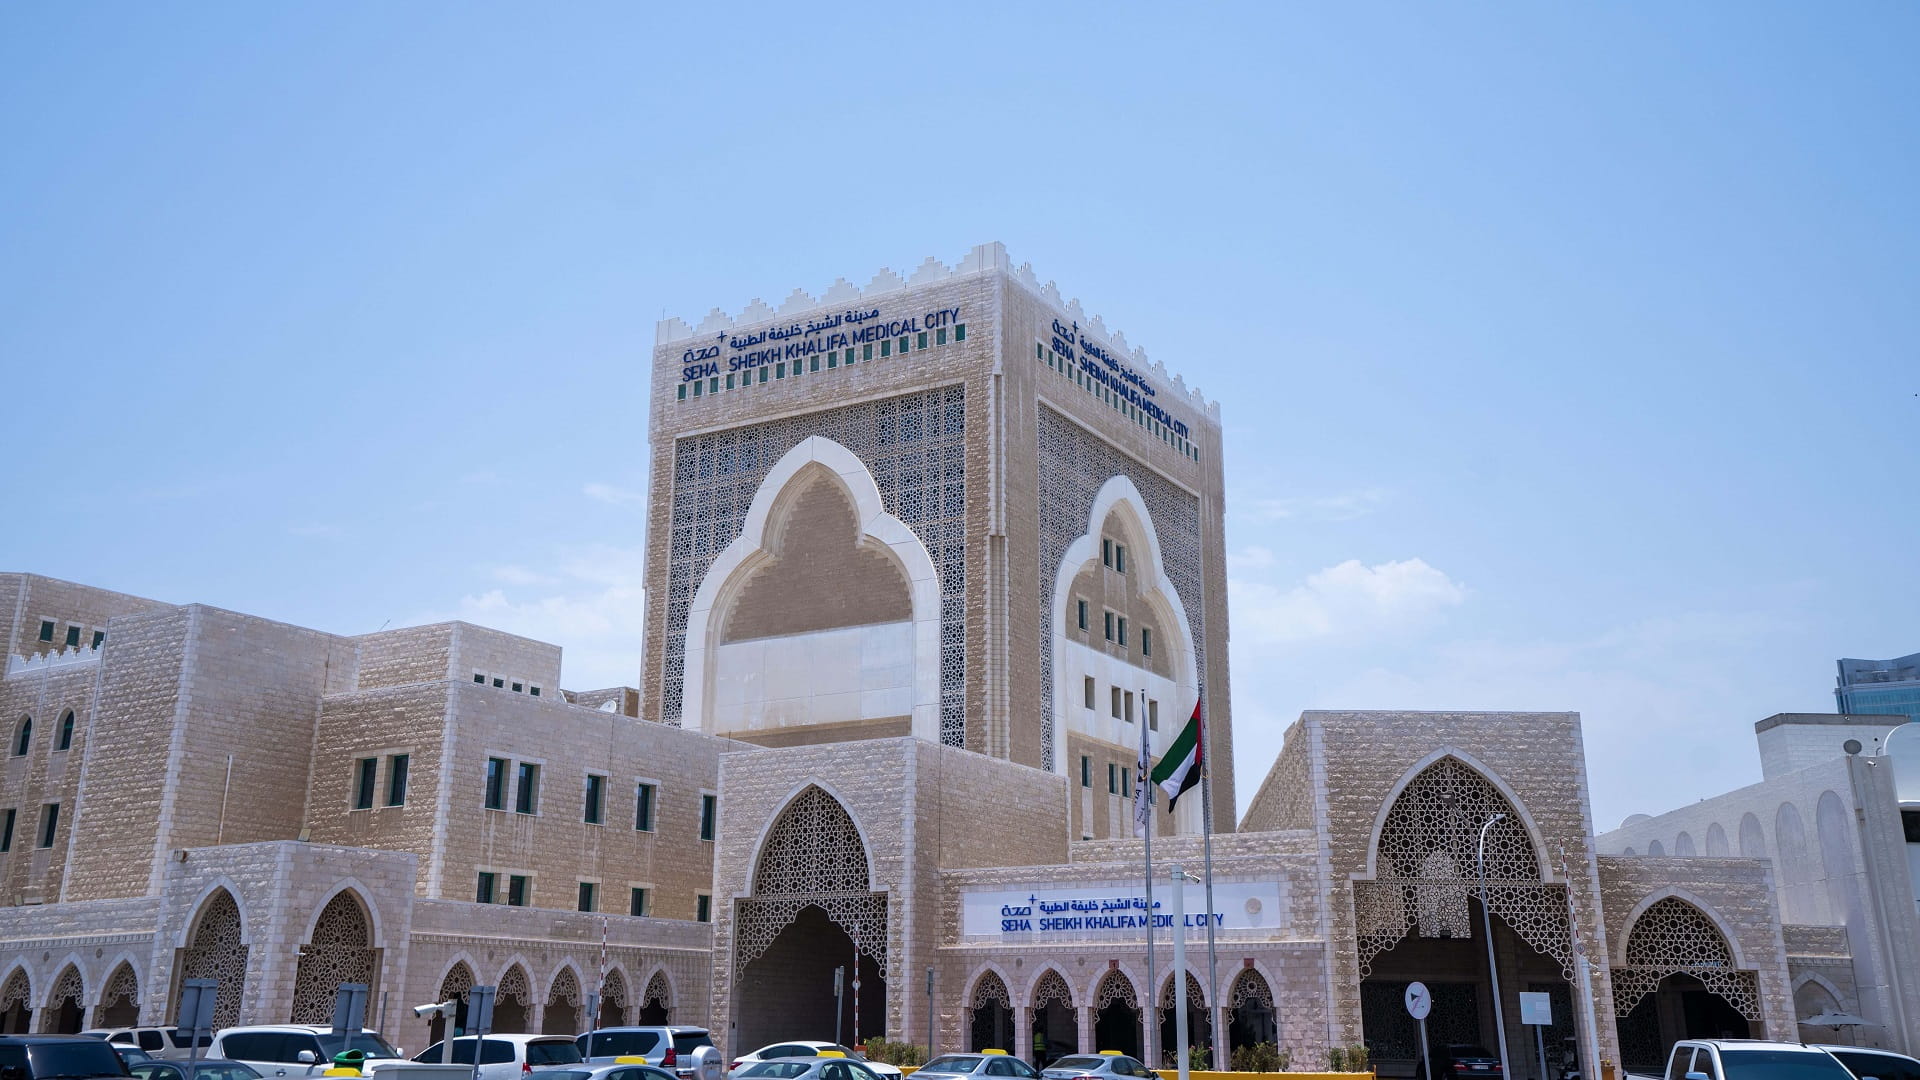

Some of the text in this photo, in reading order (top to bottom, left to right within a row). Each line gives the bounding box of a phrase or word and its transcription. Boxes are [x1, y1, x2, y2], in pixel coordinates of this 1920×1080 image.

[730, 309, 879, 350] مدينة الشيخ خليفة الطبية
[682, 308, 960, 383] SEHA SHEIKH KHALIFA MEDICAL CITY
[683, 346, 720, 363] صحة
[1052, 336, 1189, 440] SEHA SHEIKH KHALIFA MEDICAL CITY
[1002, 904, 1032, 916] صحة
[1040, 898, 1161, 915] مينة الشيخ خليفة الطبية
[1002, 913, 1223, 932] SEHA SHEIKH KHALIFA MEDICL CIY
